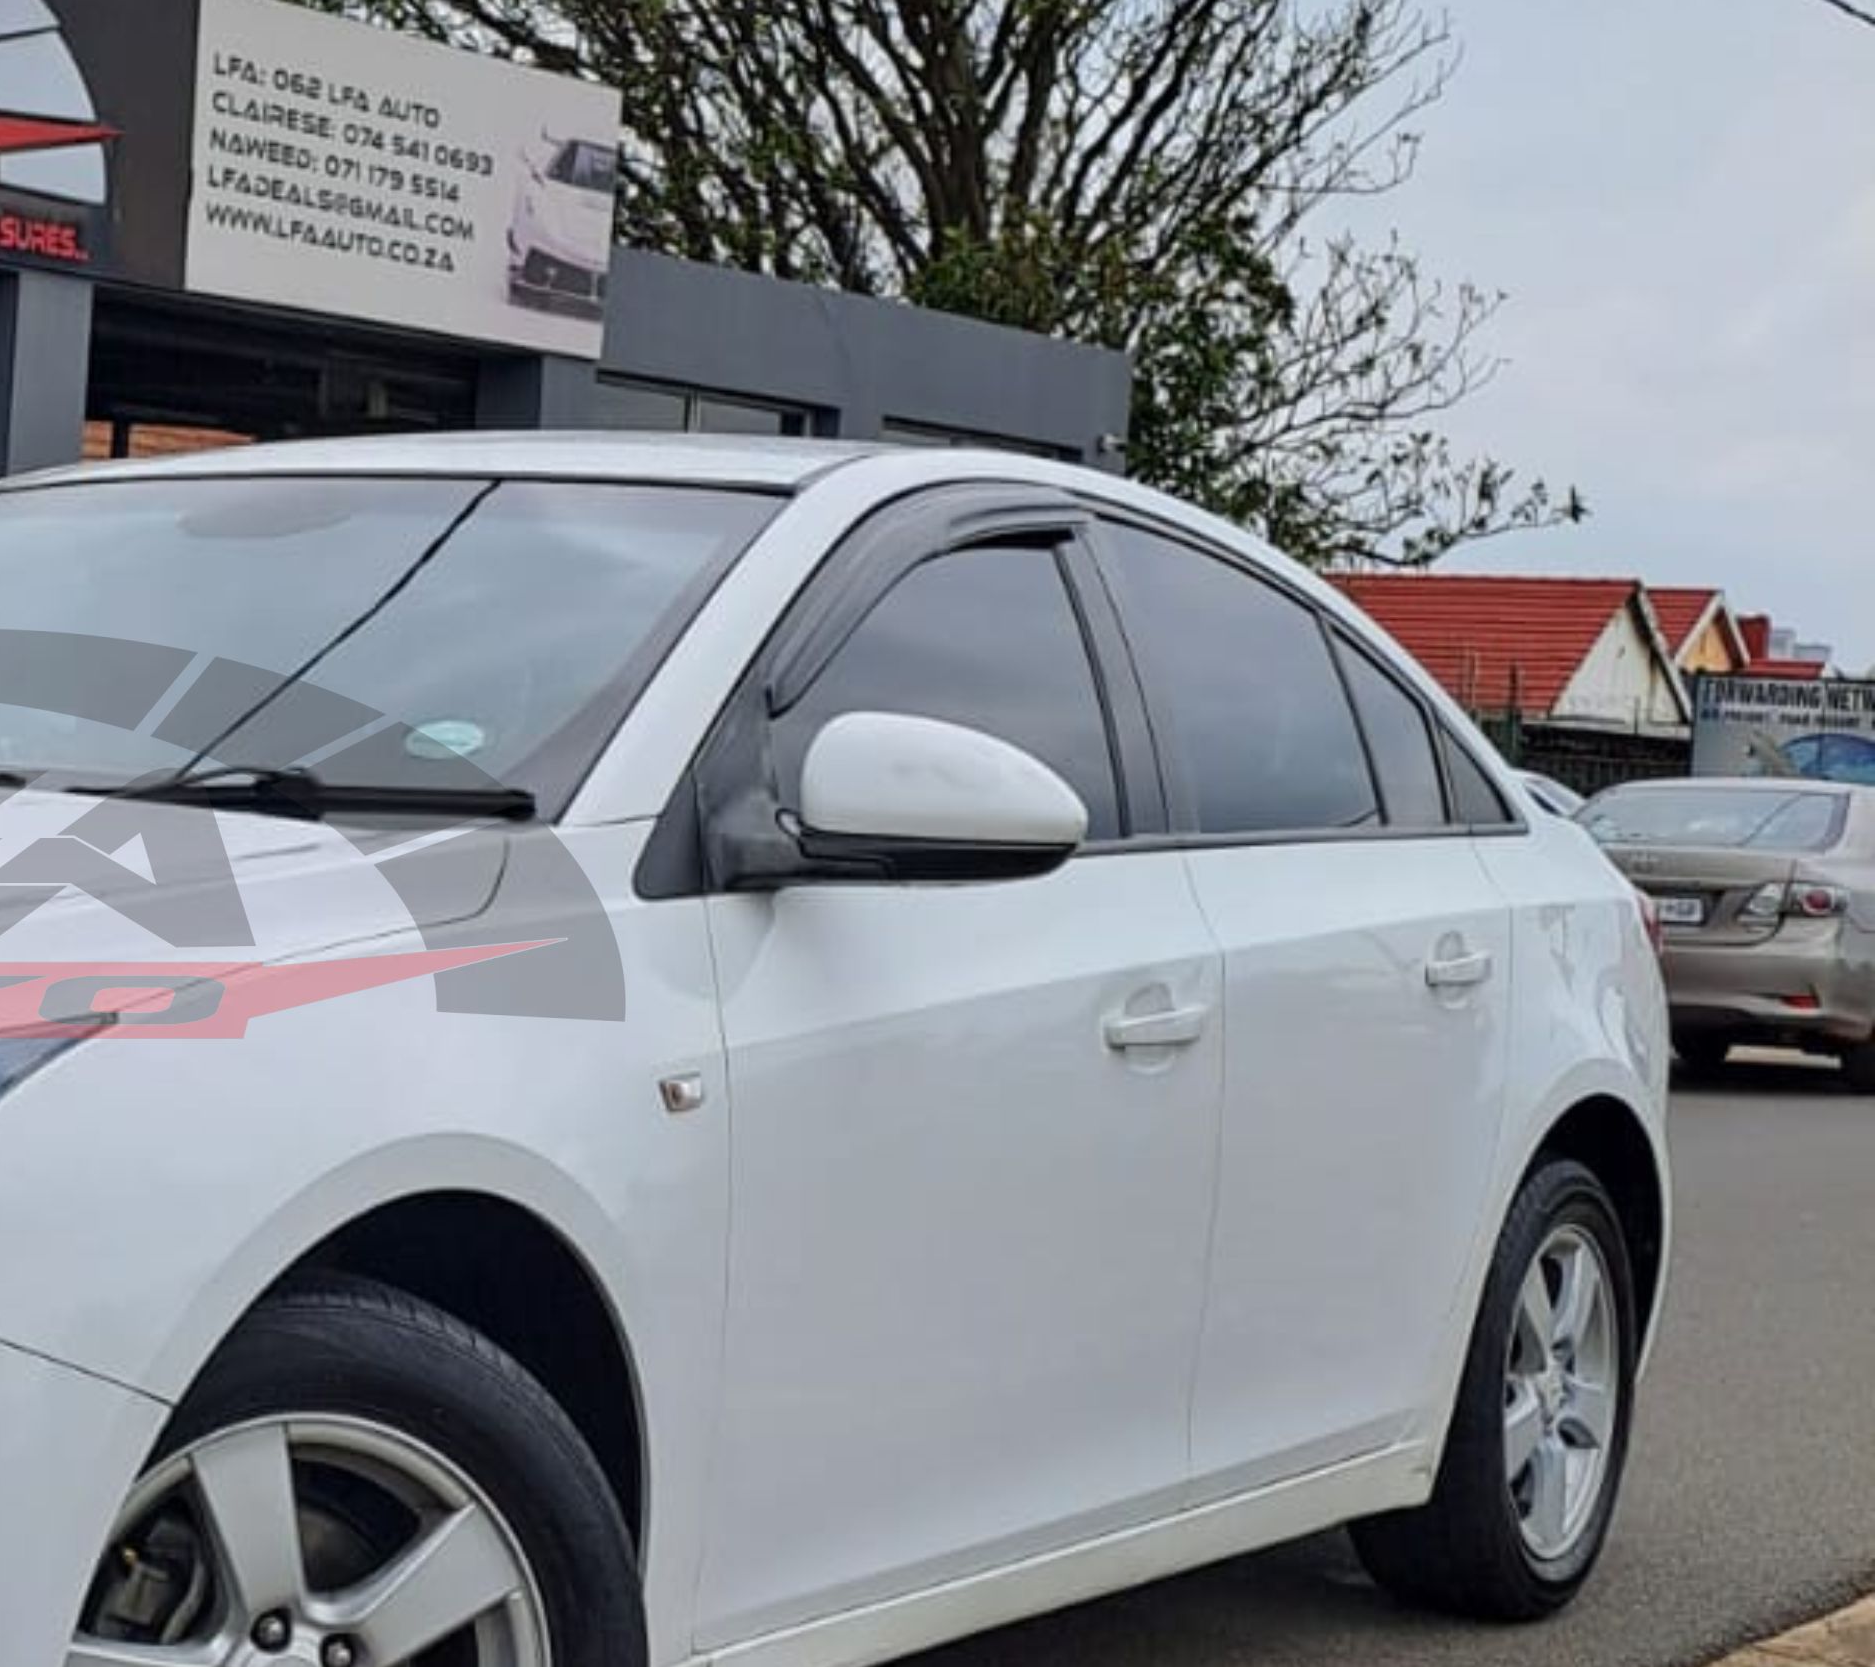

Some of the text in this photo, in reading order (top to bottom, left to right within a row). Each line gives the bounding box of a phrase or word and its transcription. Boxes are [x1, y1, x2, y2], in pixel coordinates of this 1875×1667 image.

[213, 50, 441, 129] LFA: 062 LFA AUTO
[325, 153, 361, 185] 071
[342, 122, 384, 151] 074
[392, 134, 430, 163] 541
[206, 200, 455, 273] WWW.LFAAUTO.CO.ZA
